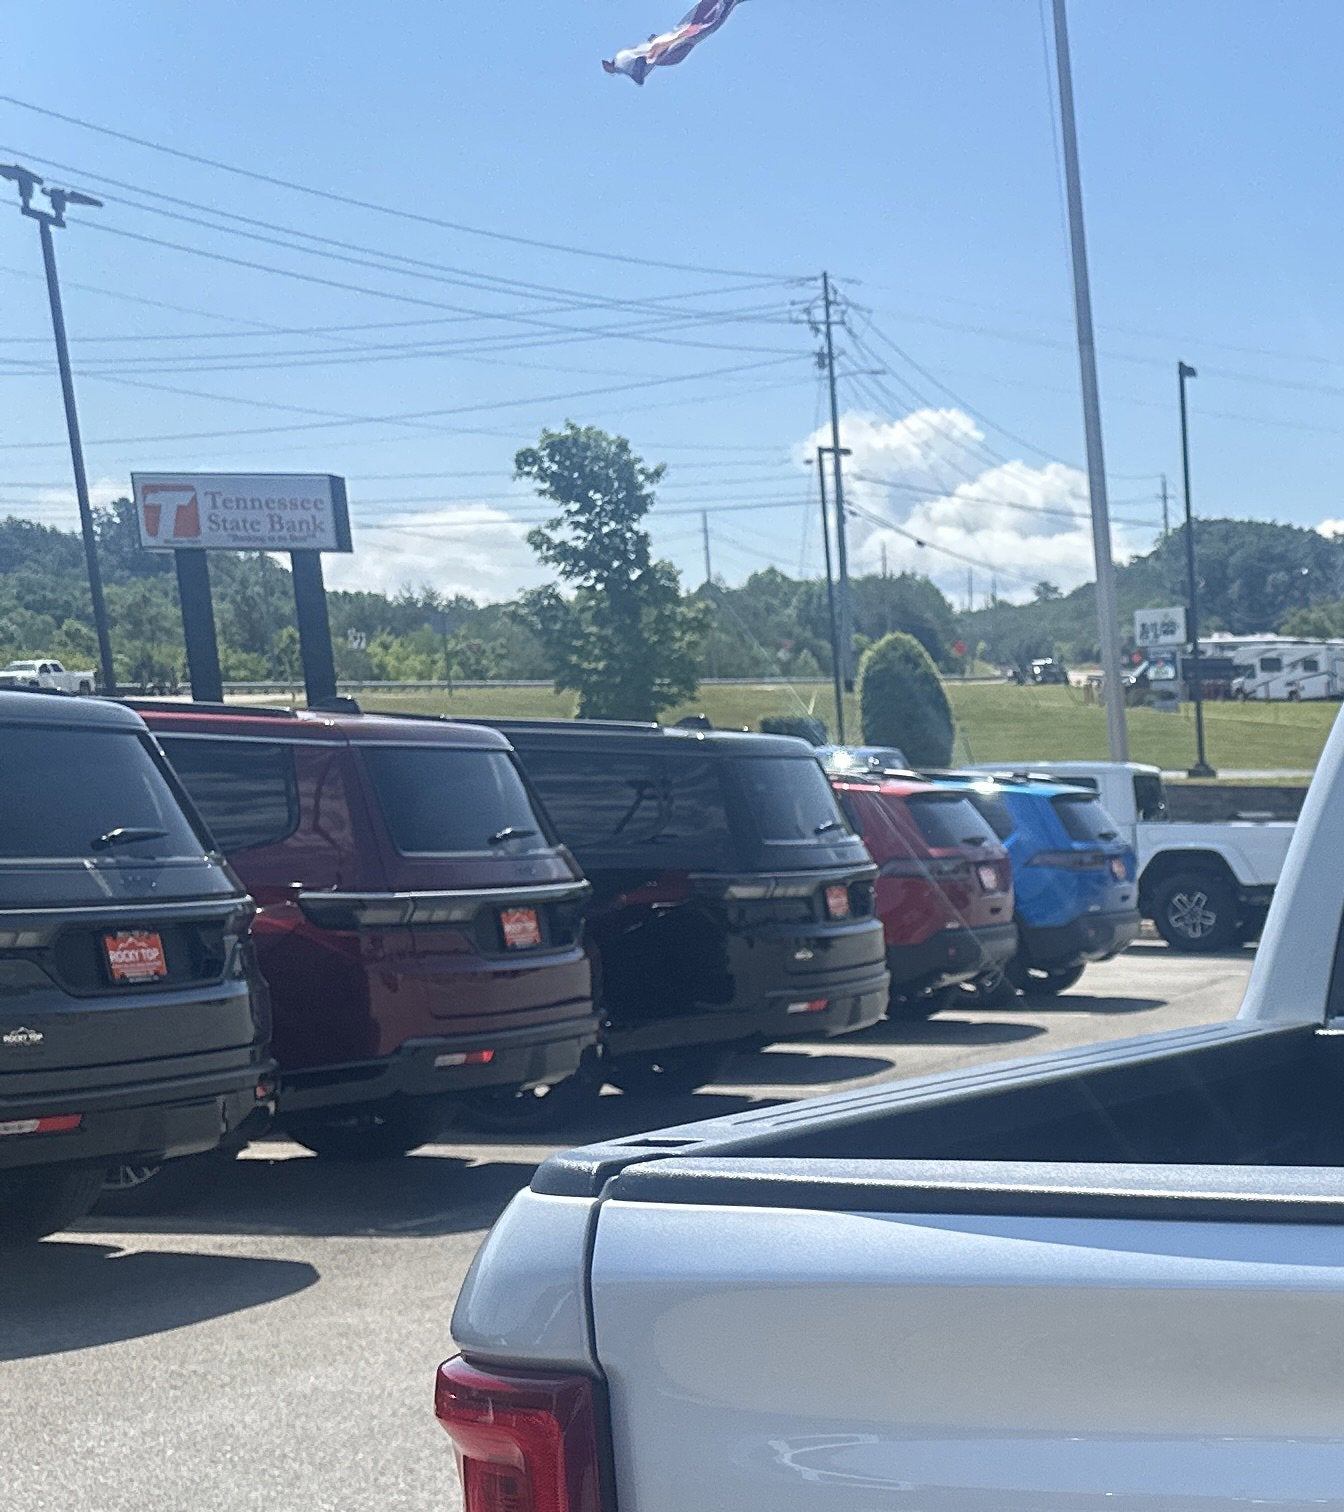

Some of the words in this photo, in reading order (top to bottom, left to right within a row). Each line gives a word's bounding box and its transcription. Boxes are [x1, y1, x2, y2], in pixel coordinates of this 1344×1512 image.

[204, 491, 325, 511] Tennessee
[207, 514, 261, 533] State
[266, 513, 325, 533] Bank
